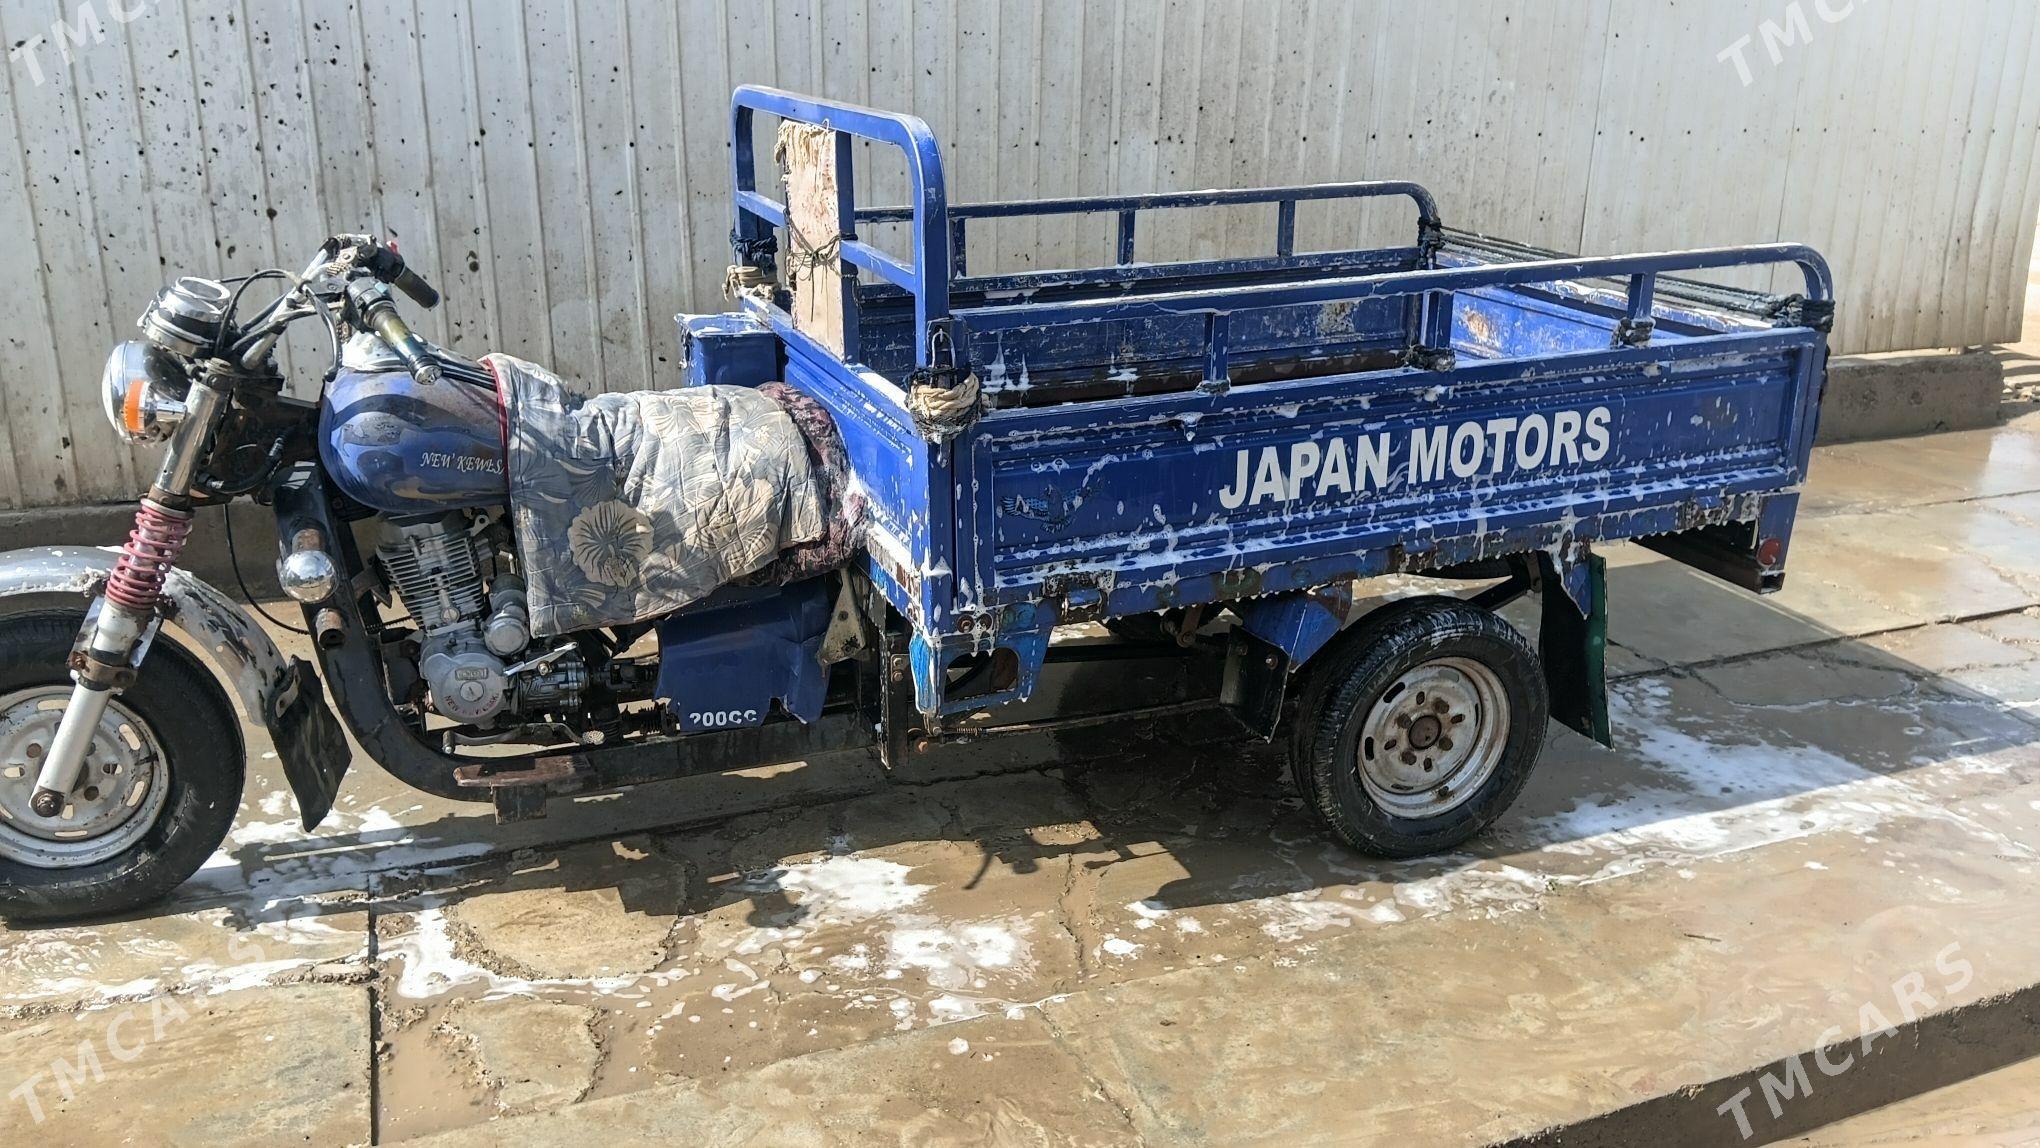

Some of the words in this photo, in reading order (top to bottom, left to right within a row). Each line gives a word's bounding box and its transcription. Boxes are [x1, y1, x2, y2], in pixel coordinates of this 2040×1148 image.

[1218, 432, 1391, 509] JAPAN
[1407, 406, 1612, 485] MOTORS
[689, 709, 757, 727] 200CC
